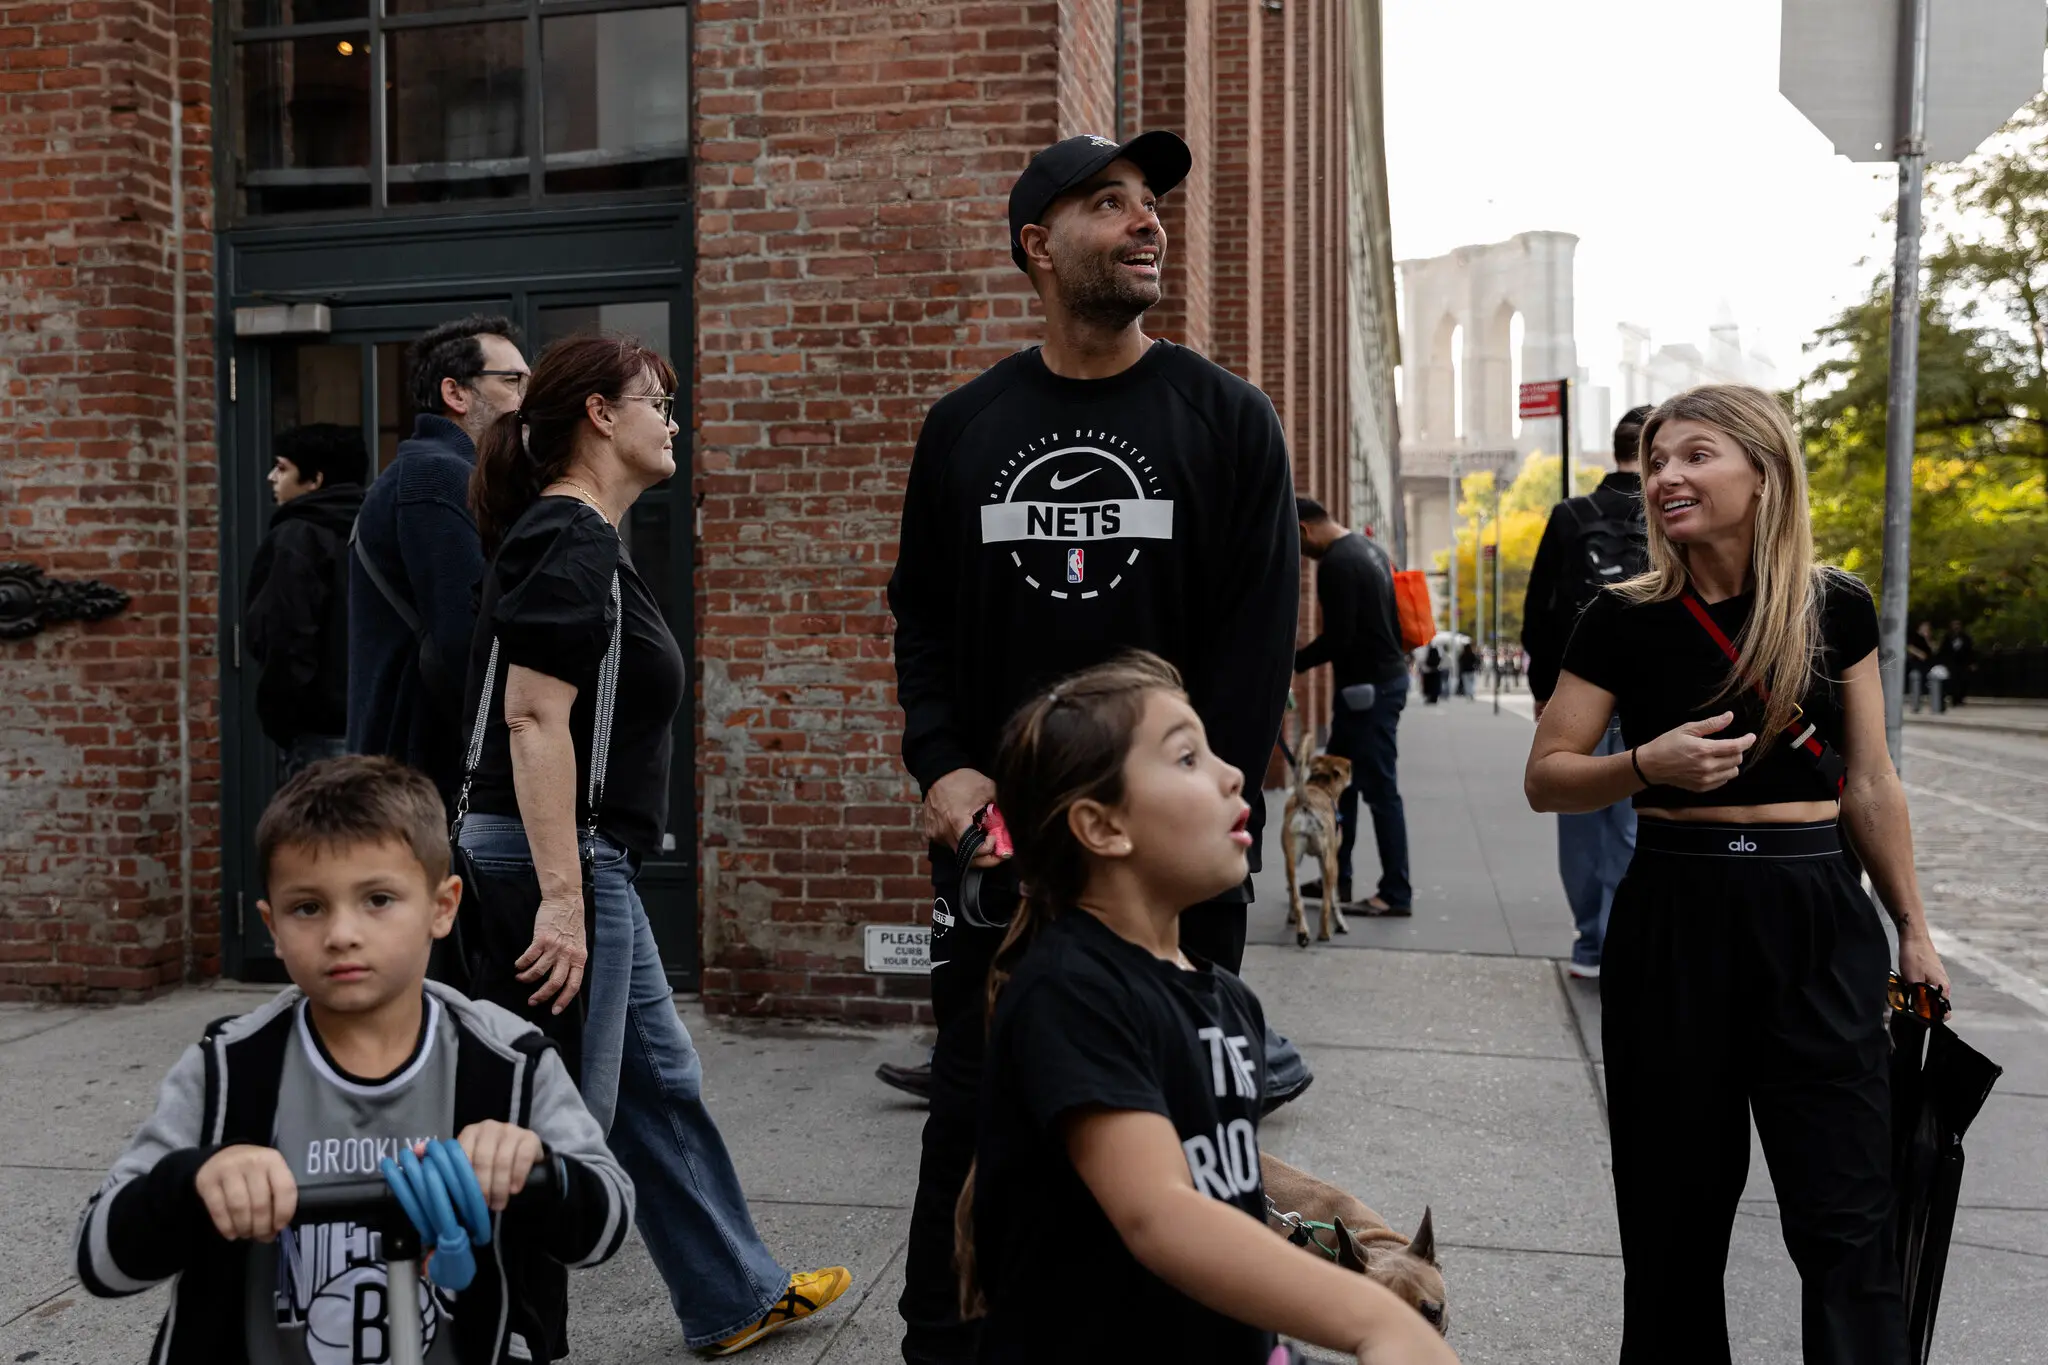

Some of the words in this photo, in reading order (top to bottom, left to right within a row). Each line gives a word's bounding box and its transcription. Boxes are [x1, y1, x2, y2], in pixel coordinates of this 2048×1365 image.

[990, 432, 1059, 499] BROOKLYN
[1075, 429, 1162, 495] BASKETBALL
[1027, 503, 1120, 537] NETS
[1728, 834, 1757, 852] alo
[880, 932, 931, 945] PLEASE
[895, 946, 923, 956] CURB
[883, 957, 908, 966] YOUR
